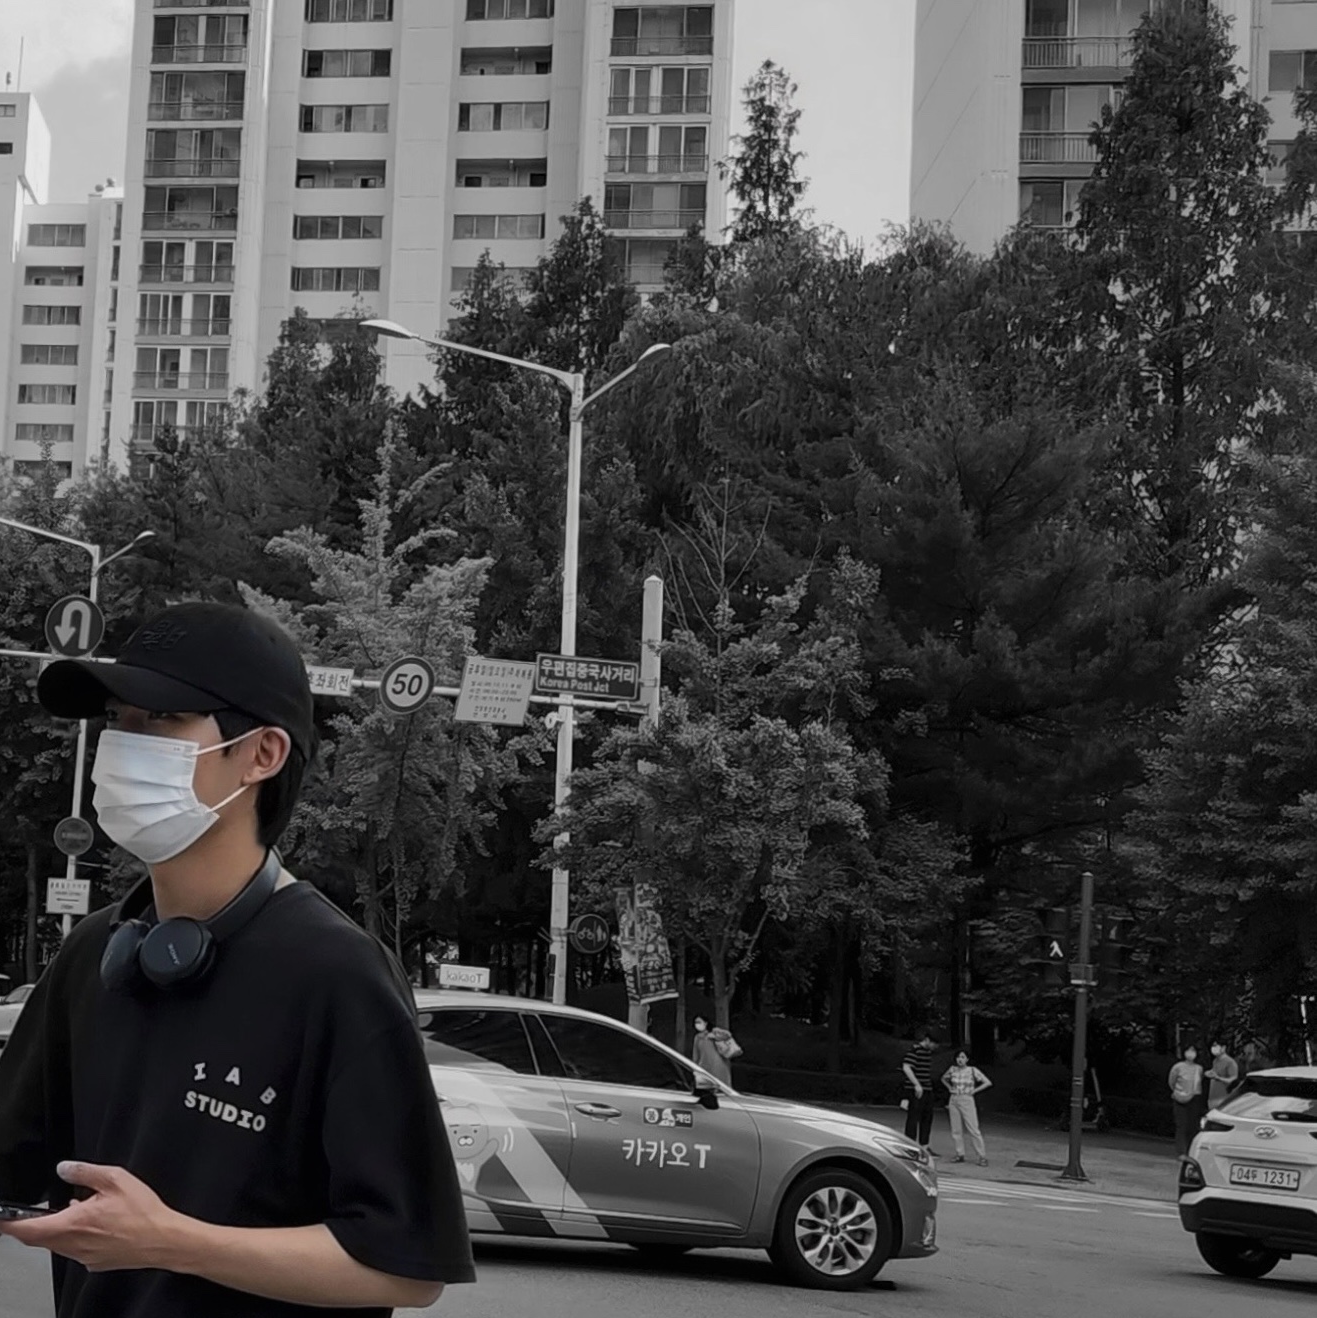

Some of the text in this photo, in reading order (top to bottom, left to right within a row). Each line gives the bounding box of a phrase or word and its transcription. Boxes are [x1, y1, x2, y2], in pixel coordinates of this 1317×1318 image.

[541, 659, 636, 683] 우편집중국사거리
[391, 673, 423, 696] 50
[540, 676, 569, 688] Korea
[570, 679, 592, 691] Post
[184, 1090, 266, 1132] STUDIO
[1263, 1170, 1291, 1186] 1231
